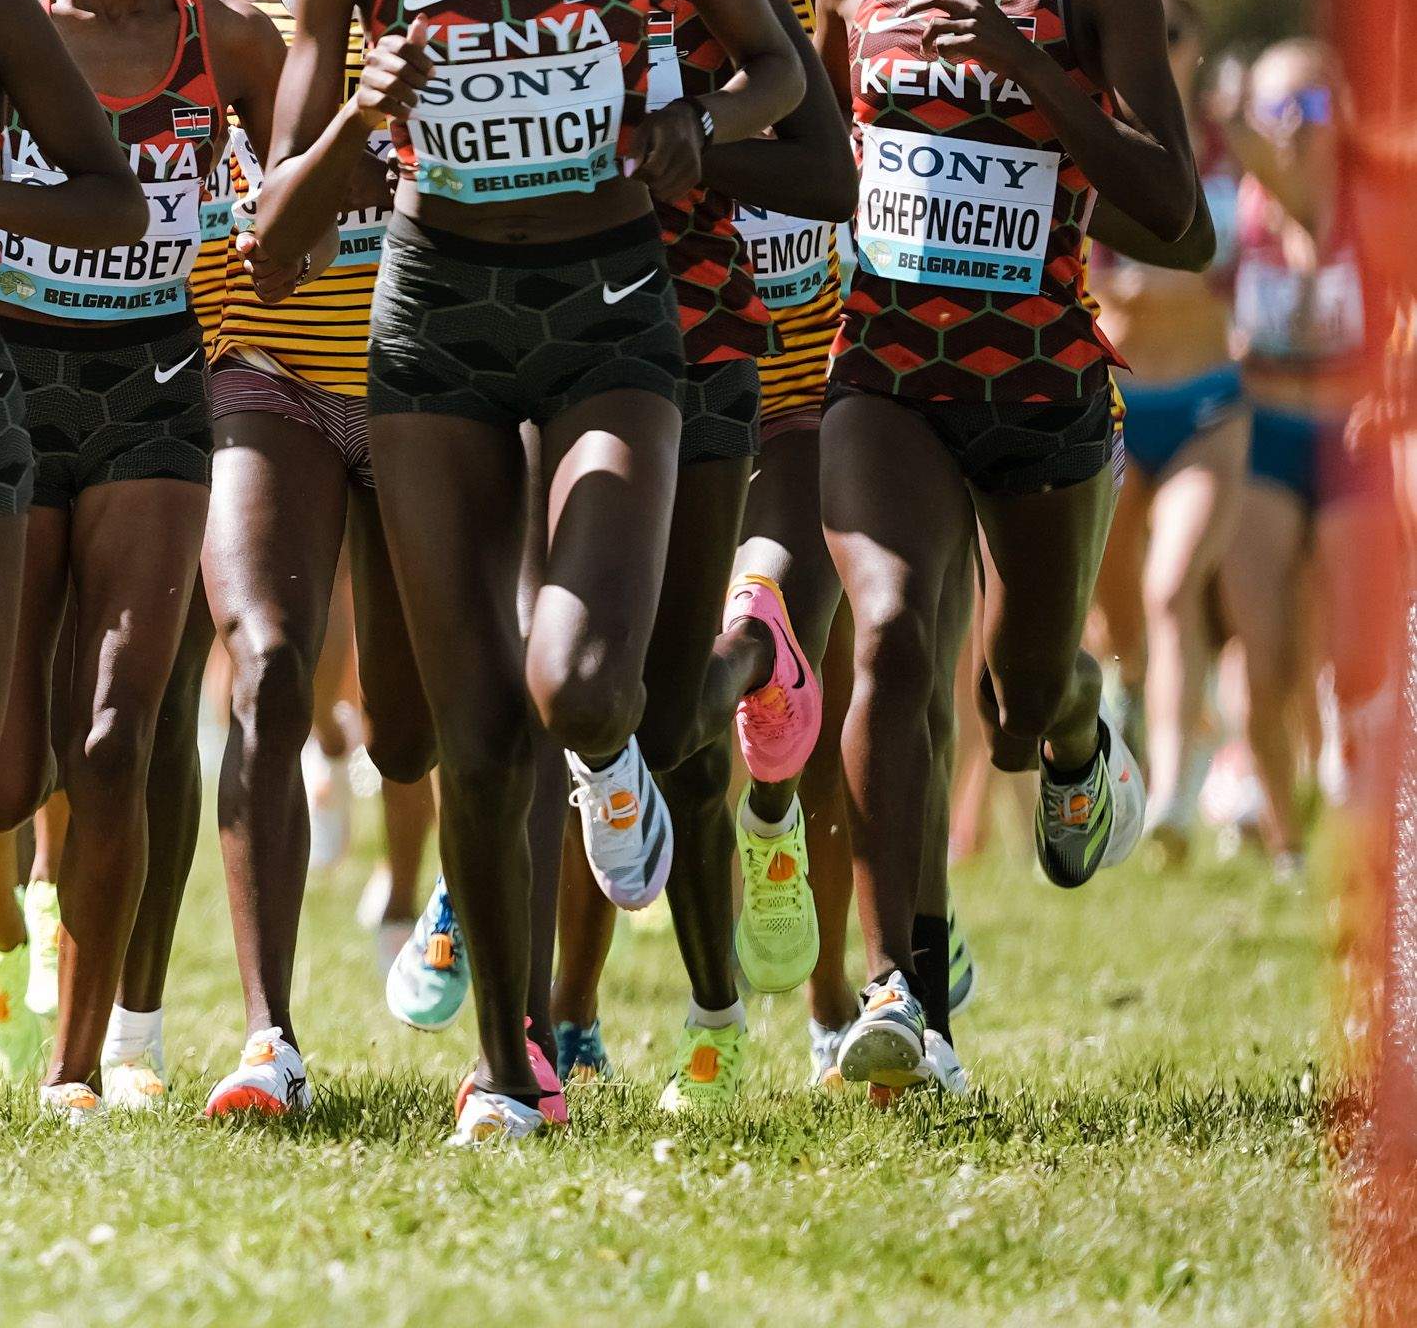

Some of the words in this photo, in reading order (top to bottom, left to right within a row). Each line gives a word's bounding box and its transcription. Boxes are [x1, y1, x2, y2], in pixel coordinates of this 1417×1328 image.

[420, 60, 600, 107] SONY
[860, 57, 1033, 106] KENYA
[419, 105, 612, 164] NGETICH
[472, 166, 591, 193] BELGRADE
[878, 140, 1039, 190] SONY
[867, 187, 1041, 252] CHEPNGENO
[48, 238, 193, 281] CHEBET
[898, 252, 1000, 280] BELGRADE
[1003, 263, 1033, 284] 24
[43, 287, 151, 311] BELGRADE
[153, 286, 178, 305] 24
